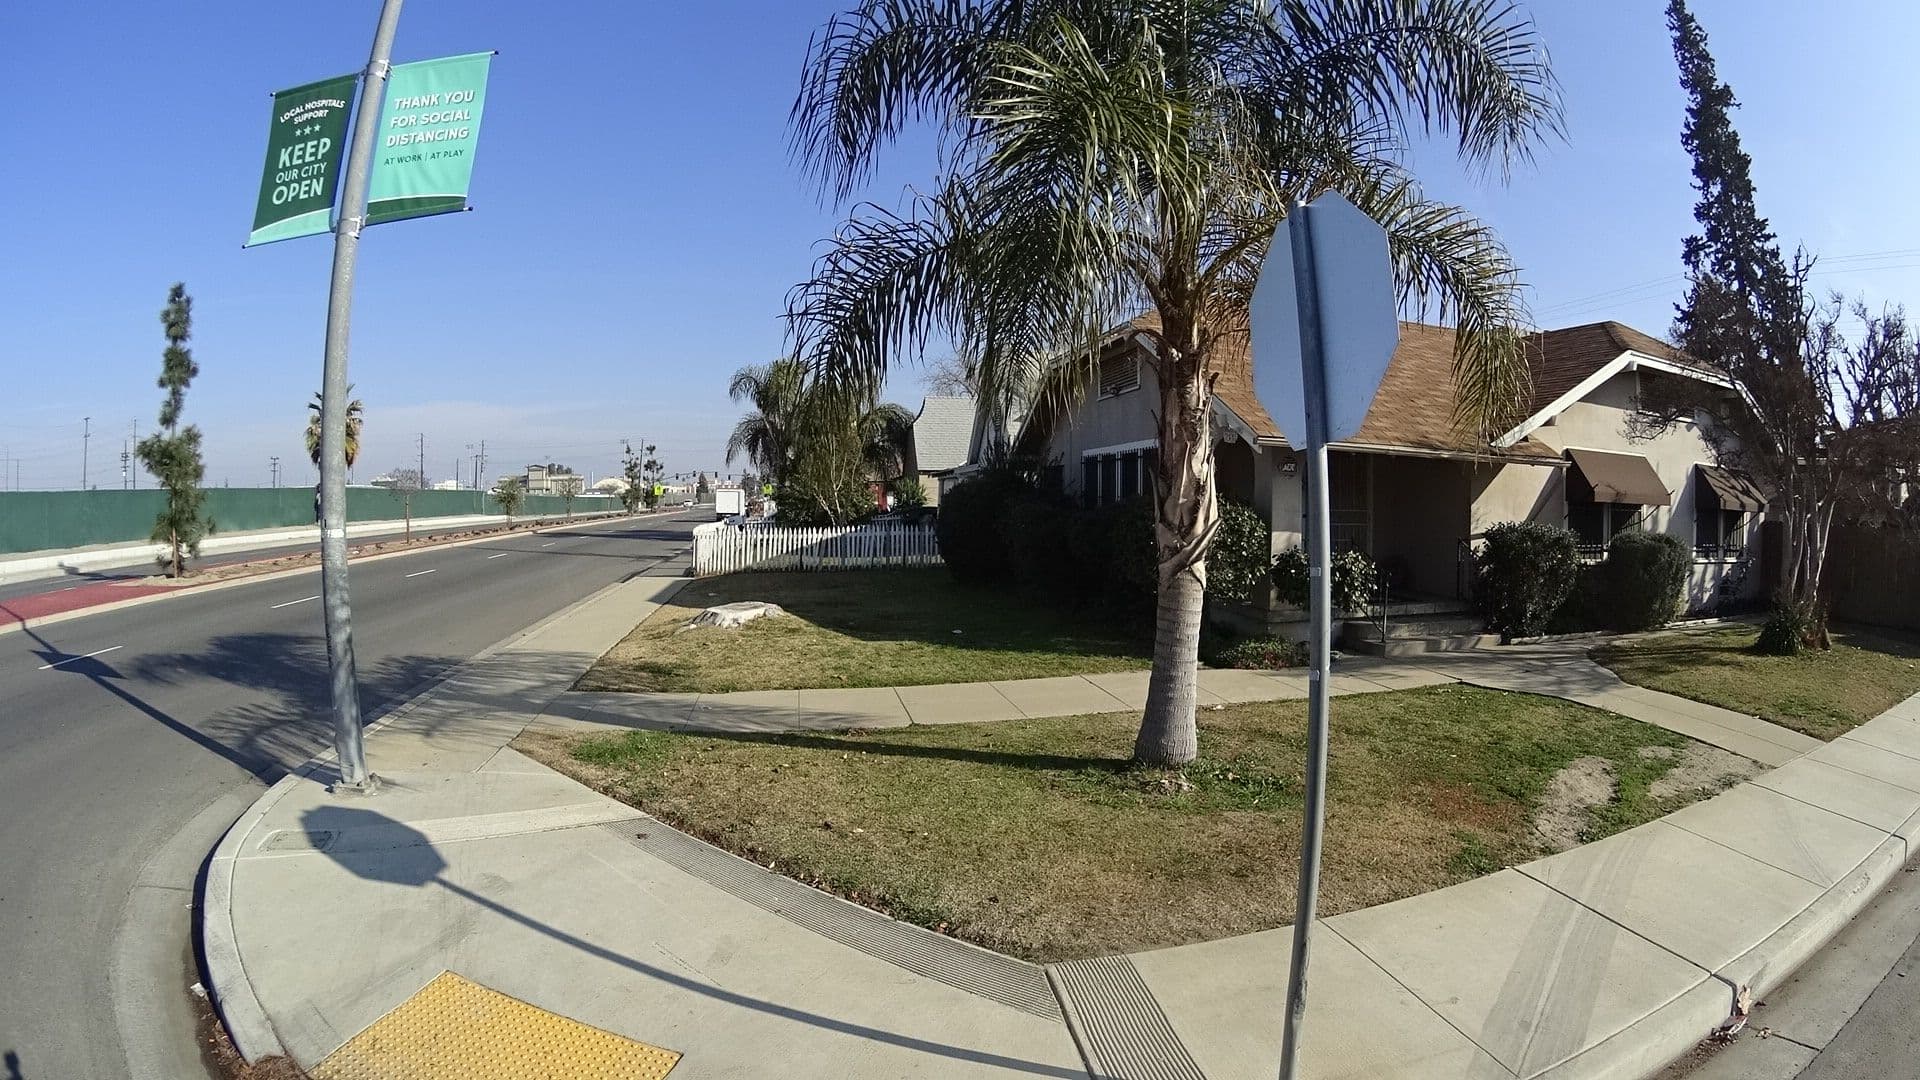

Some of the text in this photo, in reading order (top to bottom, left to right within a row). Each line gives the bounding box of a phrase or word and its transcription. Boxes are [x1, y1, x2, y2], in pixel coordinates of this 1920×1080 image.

[394, 89, 474, 110] THANK YOU
[280, 99, 345, 123] LOCAL HOSPITALS
[294, 110, 328, 124] SUPPORT
[390, 109, 471, 129] FOR SOCIAL
[386, 128, 469, 148] DISTANCING
[279, 138, 331, 168] KEEP
[384, 149, 464, 166] AT WORK AT PLAY
[275, 162, 327, 183] OUR CITY
[272, 177, 324, 205] OPEN
